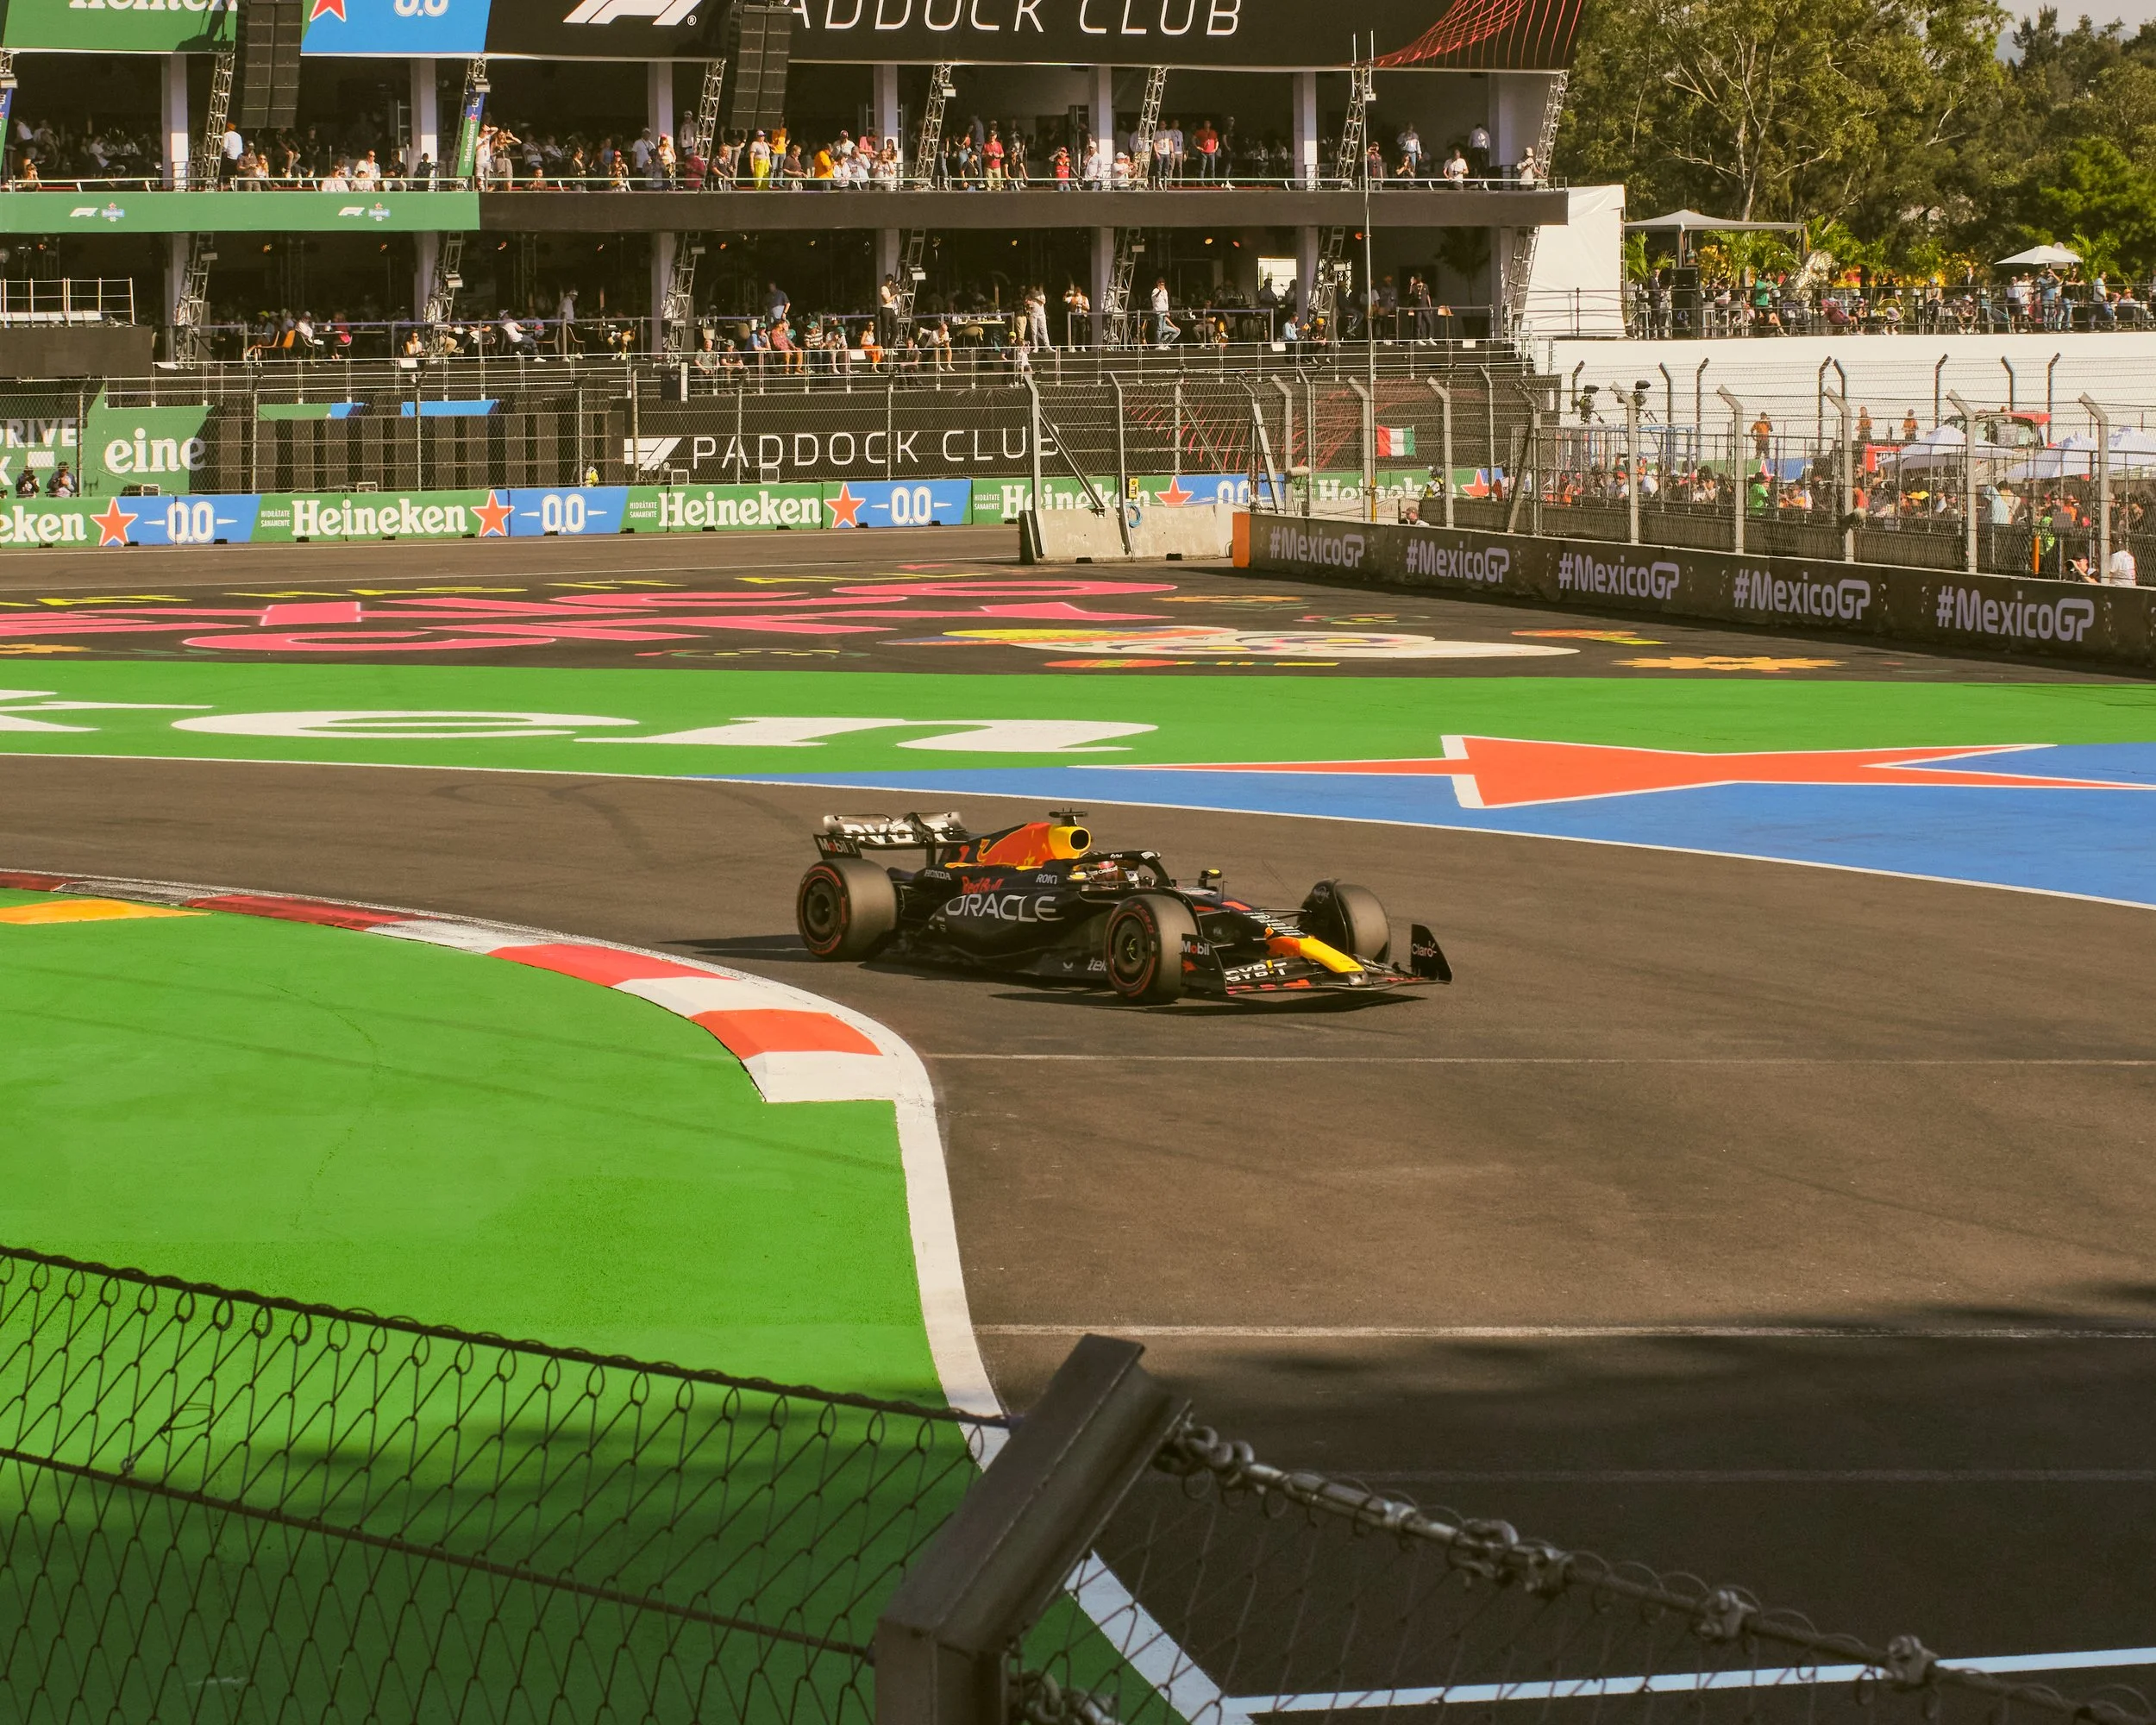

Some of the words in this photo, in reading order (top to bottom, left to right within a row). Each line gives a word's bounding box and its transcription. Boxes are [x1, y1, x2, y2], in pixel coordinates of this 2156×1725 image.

[0, 418, 77, 448] RIVE
[693, 430, 919, 469] PADDOCK
[166, 501, 215, 543] 0.0
[291, 498, 468, 536] Heineken
[542, 493, 586, 533] 0.0
[658, 491, 822, 527] Heineken
[891, 486, 933, 524] 0.0
[1269, 525, 1365, 568] #MexicoGP
[1406, 538, 1510, 583] #MexicoGP
[1558, 552, 1680, 599] #MexicoGP
[1733, 568, 1871, 620] #MexicoGP
[1936, 585, 2095, 642] #MexicoGP
[820, 837, 849, 853] Mobil
[924, 869, 952, 881] HONDA
[945, 893, 1065, 922] ORACLE
[1180, 940, 1210, 956] Mobil
[1412, 943, 1433, 957] Claro
